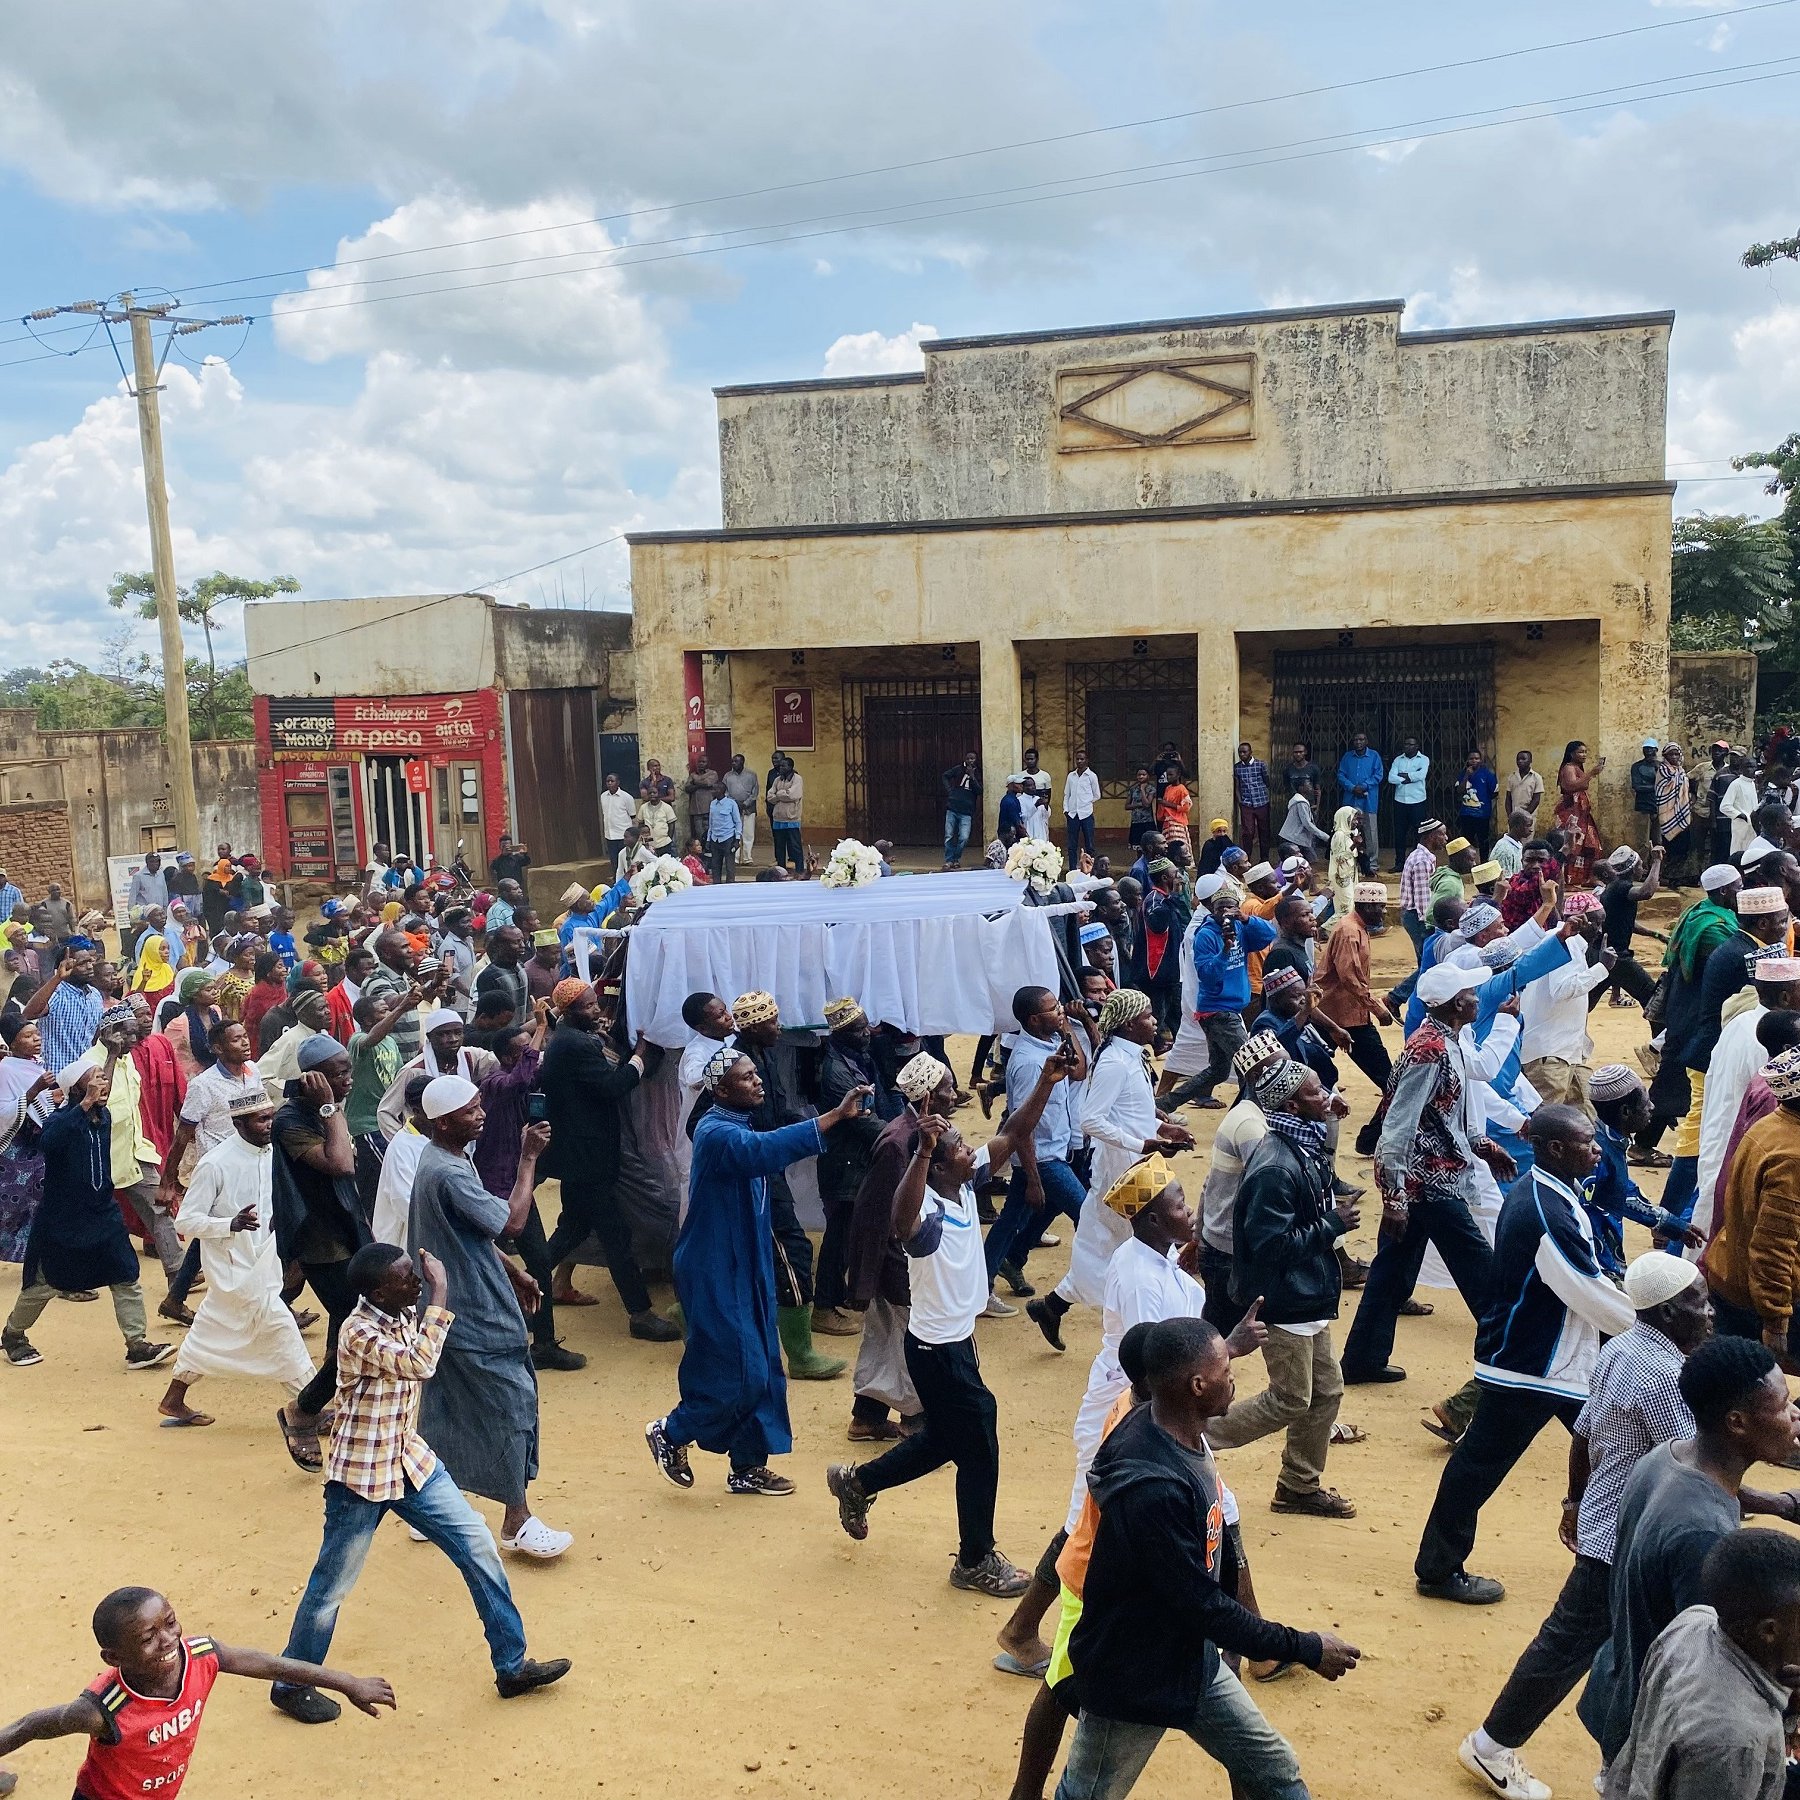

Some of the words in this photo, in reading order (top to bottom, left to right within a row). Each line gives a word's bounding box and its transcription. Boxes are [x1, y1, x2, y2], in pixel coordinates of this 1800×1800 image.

[284, 717, 335, 733] orange
[783, 712, 803, 724] airtel
[435, 719, 475, 736] airtel
[285, 732, 333, 751] Money
[342, 729, 422, 750] m-pesa
[162, 1698, 202, 1742] NBA
